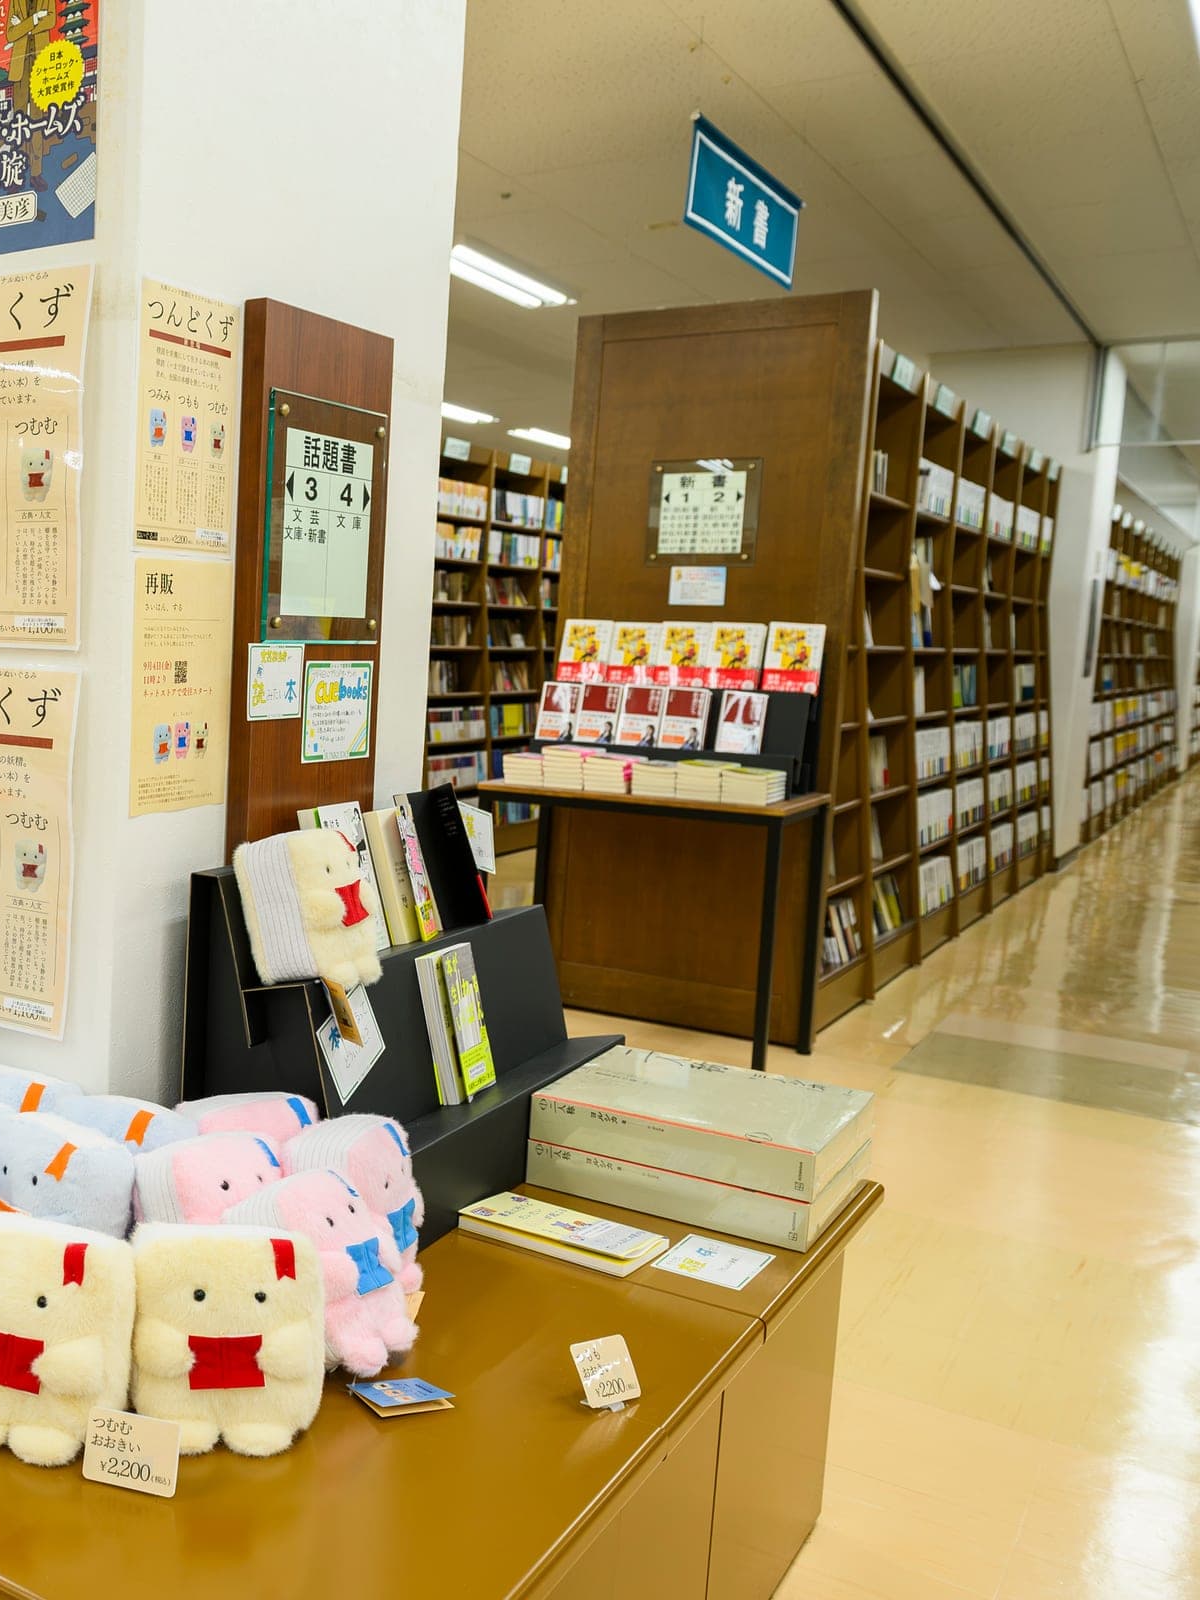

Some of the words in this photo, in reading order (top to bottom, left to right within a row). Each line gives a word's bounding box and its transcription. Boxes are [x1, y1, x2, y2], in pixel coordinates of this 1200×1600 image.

[49, 51, 63, 61] 日本
[42, 72, 69, 85] ホームズ
[37, 82, 75, 98] 大賞受賞作
[724, 176, 770, 250] 新書
[148, 301, 235, 343] つんどくず
[148, 388, 171, 402] つみみ
[178, 395, 199, 410] つもも
[208, 402, 228, 416] つむむ
[14, 416, 58, 436] つむむ
[303, 435, 357, 475] 話題書
[305, 477, 318, 501] 3
[340, 483, 353, 507] 4
[683, 493, 689, 502] 1
[713, 491, 725, 503] 2
[292, 508, 320, 526] 文芸
[336, 514, 362, 531] 文庫
[284, 525, 327, 544] 文庫・新書
[145, 572, 174, 595] 再販
[6, 811, 48, 831] つむむ
[92, 1417, 133, 1435] つむむ
[90, 1433, 141, 1453] おおきい
